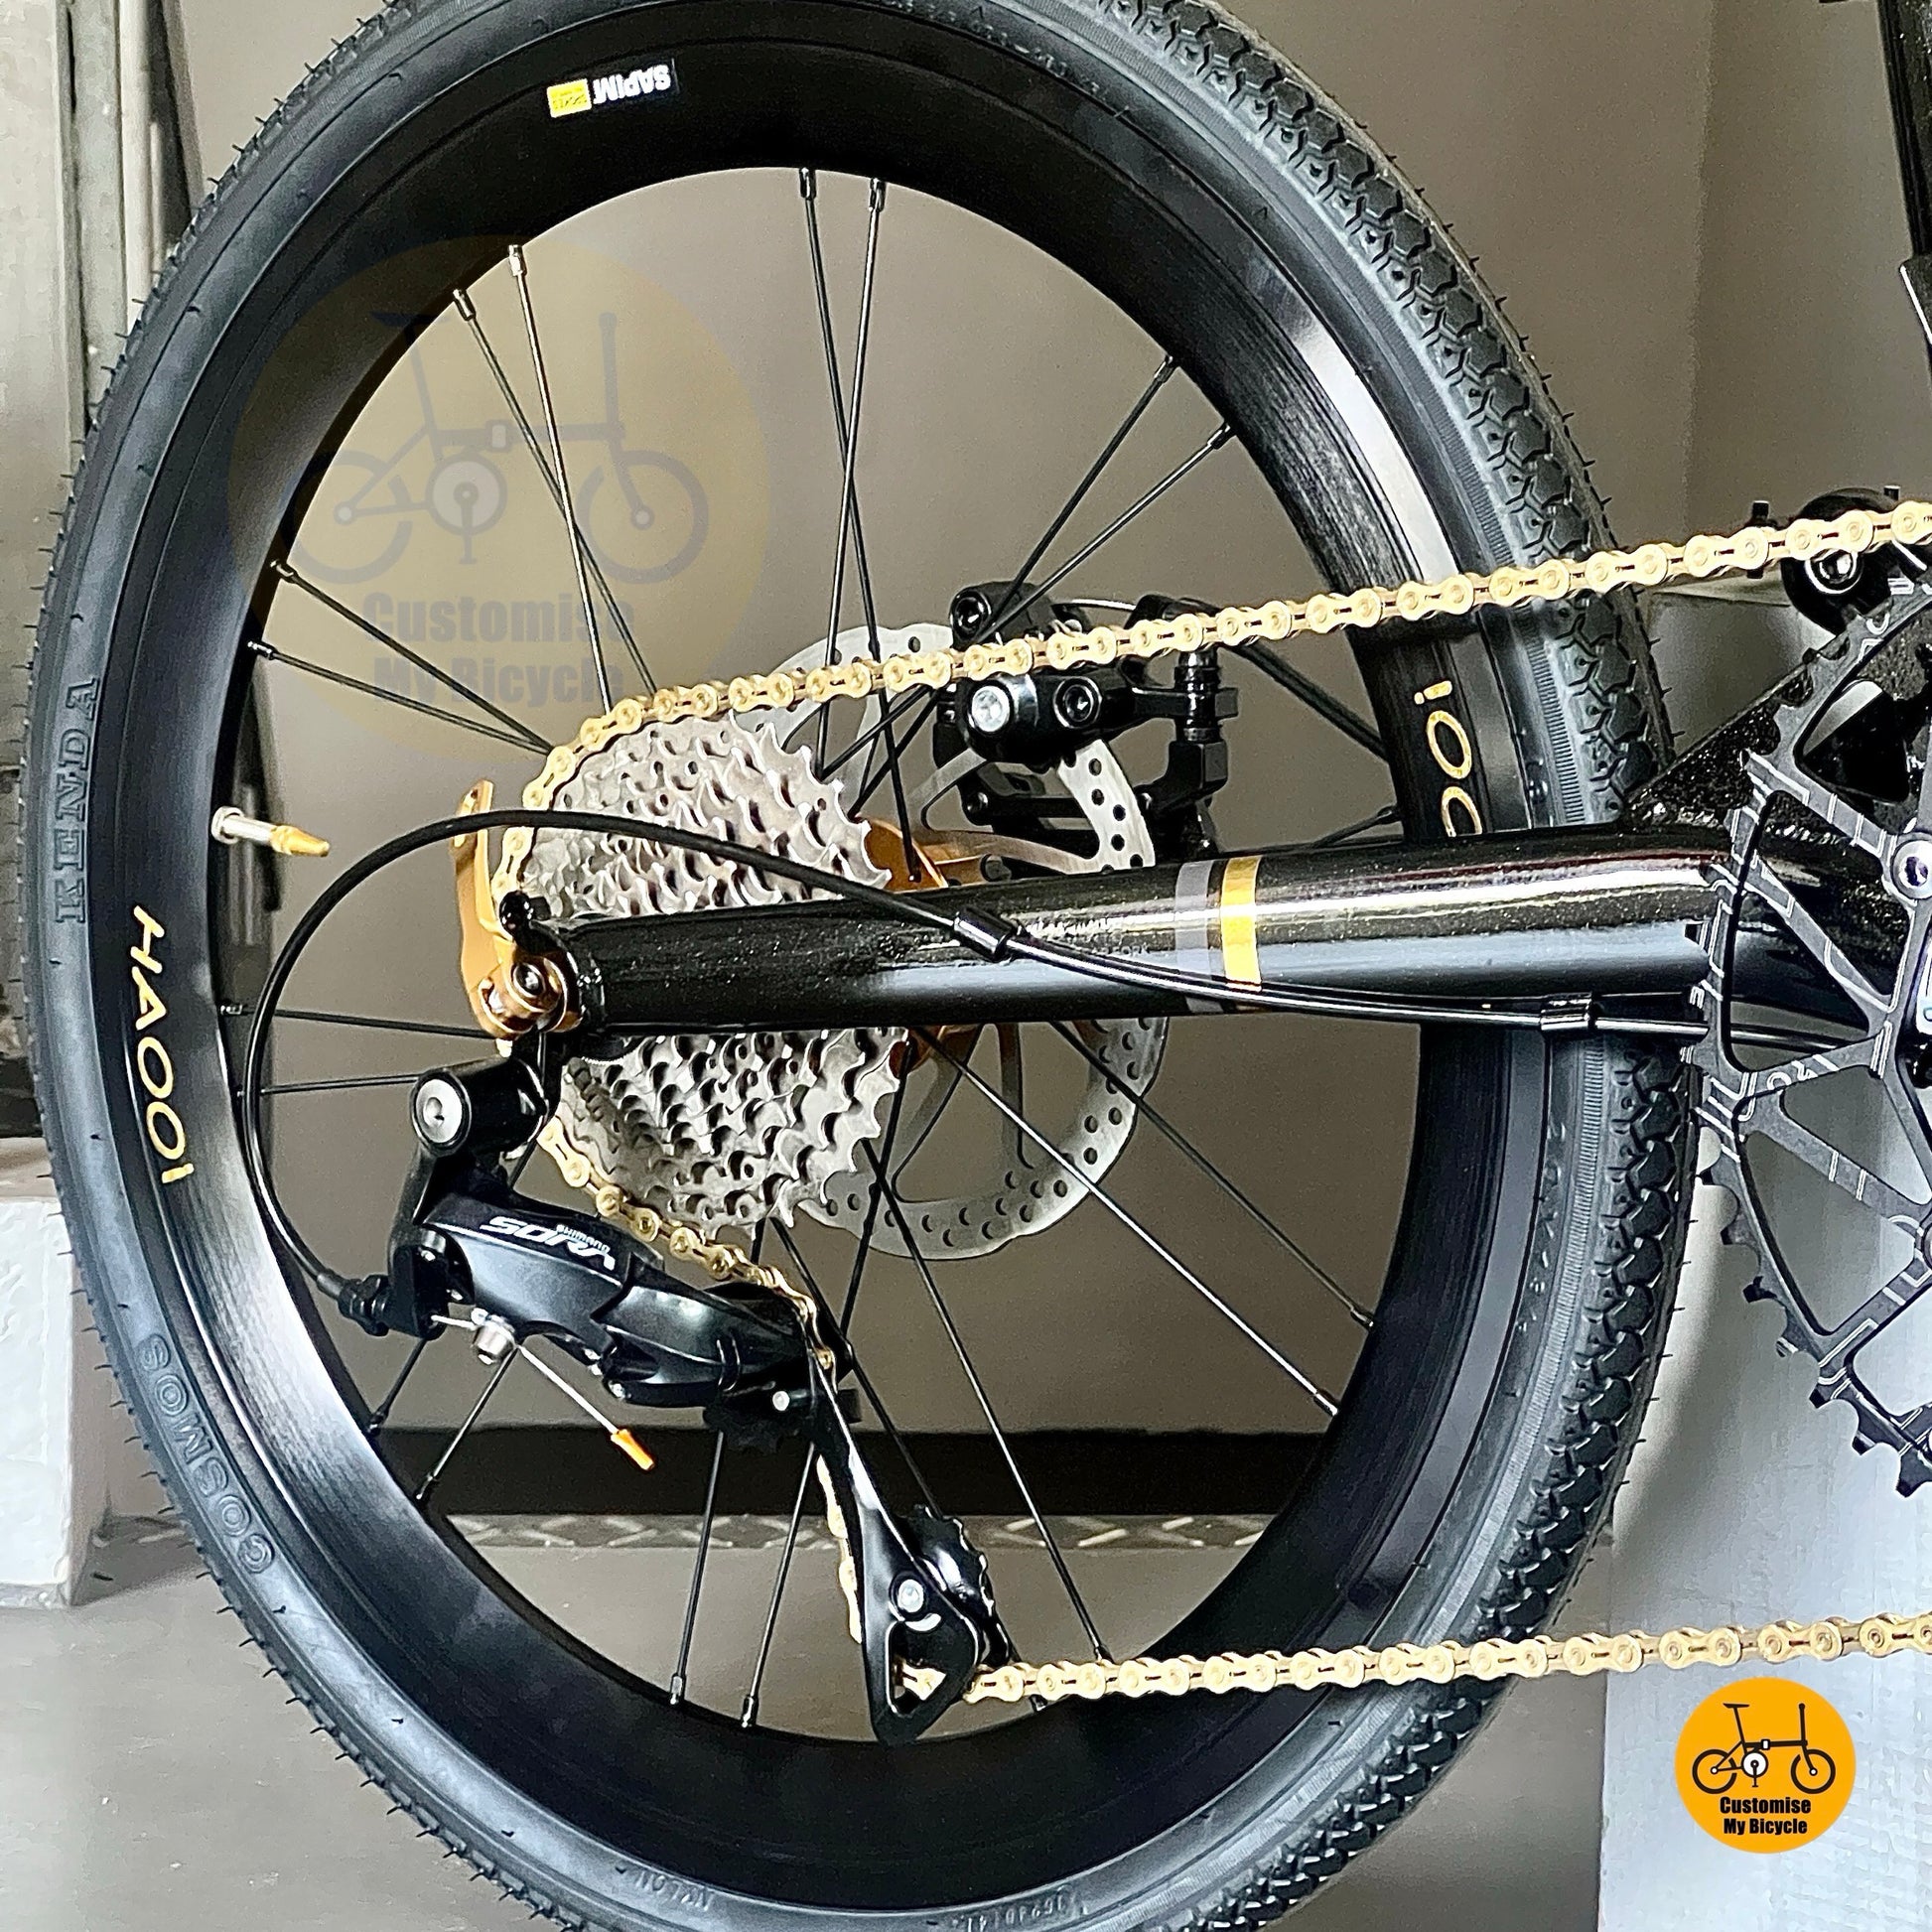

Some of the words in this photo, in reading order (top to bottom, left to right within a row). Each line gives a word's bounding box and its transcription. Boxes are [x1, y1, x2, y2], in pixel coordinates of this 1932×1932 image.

[593, 64, 672, 105] SAPIM
[54, 677, 99, 923] KENDA
[480, 1215, 616, 1271] SORA
[556, 1223, 611, 1254] SHIMANO
[137, 1333, 273, 1573] COSMOS
